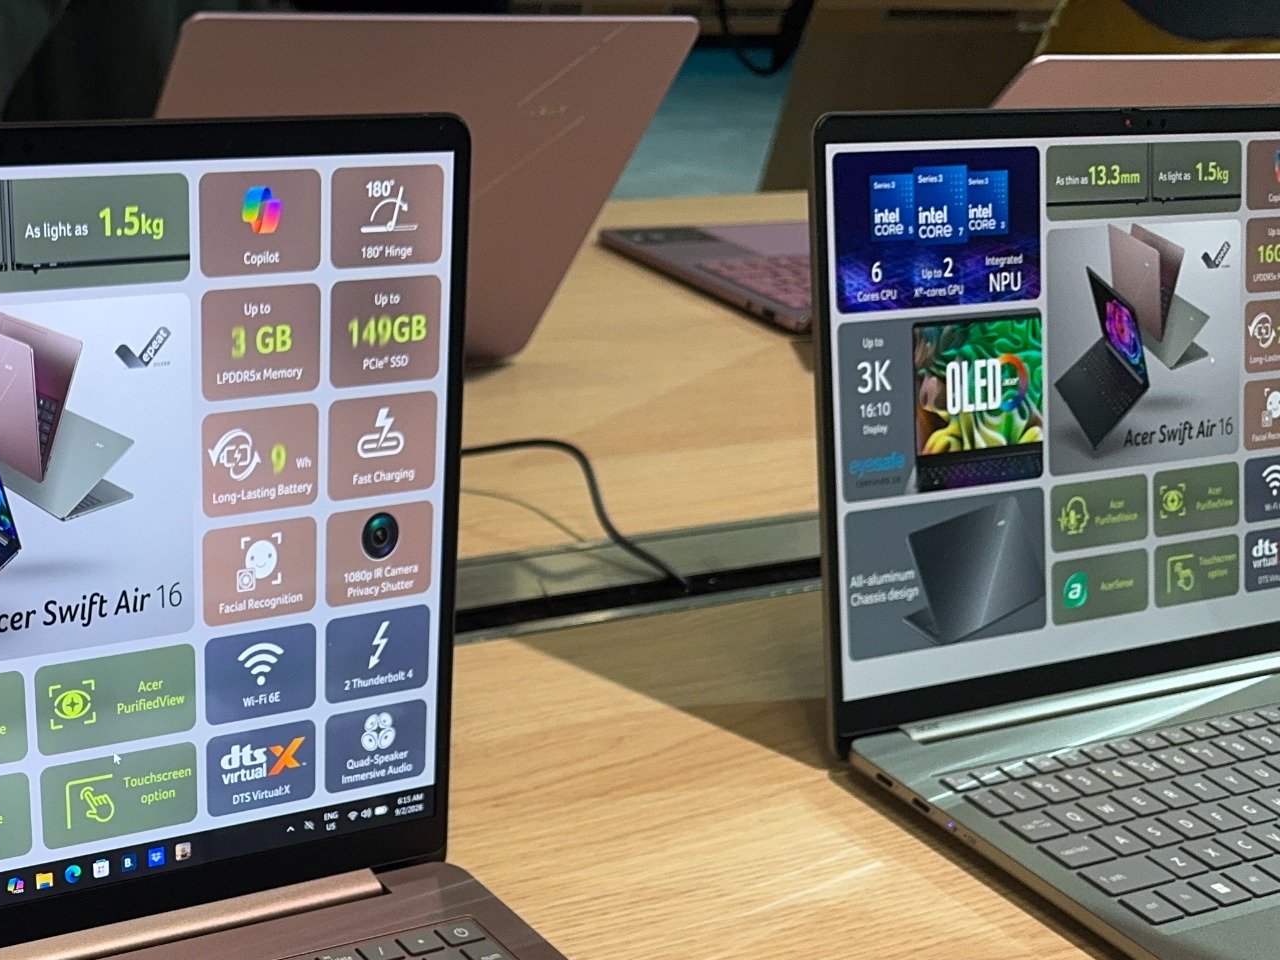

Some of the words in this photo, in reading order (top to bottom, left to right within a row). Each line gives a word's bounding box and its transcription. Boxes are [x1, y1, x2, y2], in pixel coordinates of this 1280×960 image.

[1088, 164, 1141, 186] 13.3mm
[1168, 170, 1182, 184] light
[1195, 161, 1229, 184] 1.5kg
[874, 208, 900, 224] intel
[918, 205, 948, 225] intel
[968, 203, 993, 219] intel
[25, 222, 41, 239] As
[43, 220, 72, 241] light
[73, 224, 89, 237] as
[98, 204, 164, 241] 1.5kg
[243, 251, 280, 267] Copilot
[385, 244, 413, 260] Hinge
[984, 253, 1023, 267] Integrated
[871, 260, 883, 283] 6
[942, 256, 954, 277] 2
[988, 271, 1022, 293] NPU
[243, 303, 258, 318] Up
[259, 303, 271, 315] to
[374, 293, 388, 308] Up
[389, 293, 400, 304] to
[141, 329, 169, 363] epeat
[255, 323, 293, 355] GB
[389, 354, 409, 369] SSD
[216, 369, 261, 386] LPDDR5x
[262, 365, 304, 383] Memory
[857, 358, 892, 394] 3K
[946, 357, 1003, 416] OLED
[859, 401, 892, 418] 16:10
[1123, 429, 1156, 448] Acer
[1159, 420, 1193, 446] Swift
[1196, 419, 1217, 437] Air
[1220, 416, 1234, 436] 16
[296, 456, 313, 469] Wh
[352, 472, 372, 486] Fast
[373, 468, 416, 485] Charging
[211, 485, 277, 505] Long-Lasting
[277, 481, 314, 498] Battery
[344, 571, 373, 585] 1080p
[373, 568, 383, 580] IR
[383, 563, 419, 578] Camera
[849, 568, 915, 590] All-aluminum
[346, 583, 380, 599] Privacy
[380, 578, 415, 593] Shutter
[850, 588, 886, 608] Chassis
[887, 584, 919, 605] design
[42, 592, 109, 628] Swift
[113, 587, 152, 616] Air
[155, 581, 183, 609] 16
[218, 599, 247, 615] Facial
[247, 591, 304, 612] Recognition
[138, 678, 164, 693] Acer
[343, 680, 351, 691] 2
[351, 670, 406, 690] Thunderbolt
[406, 668, 414, 680] 4
[116, 693, 186, 716] PurifiedView
[242, 693, 268, 708] Wi-Fi
[268, 691, 281, 704] 6E
[220, 743, 268, 770] dts
[346, 749, 409, 771] Quad-Speaker
[122, 766, 192, 789] Touchscreen
[221, 763, 268, 786] virtual
[341, 768, 386, 786] Immersive
[386, 762, 413, 777] Audio
[140, 788, 176, 805] option
[232, 791, 251, 806] DTS
[323, 810, 339, 822] ENG
[325, 822, 337, 832] US
